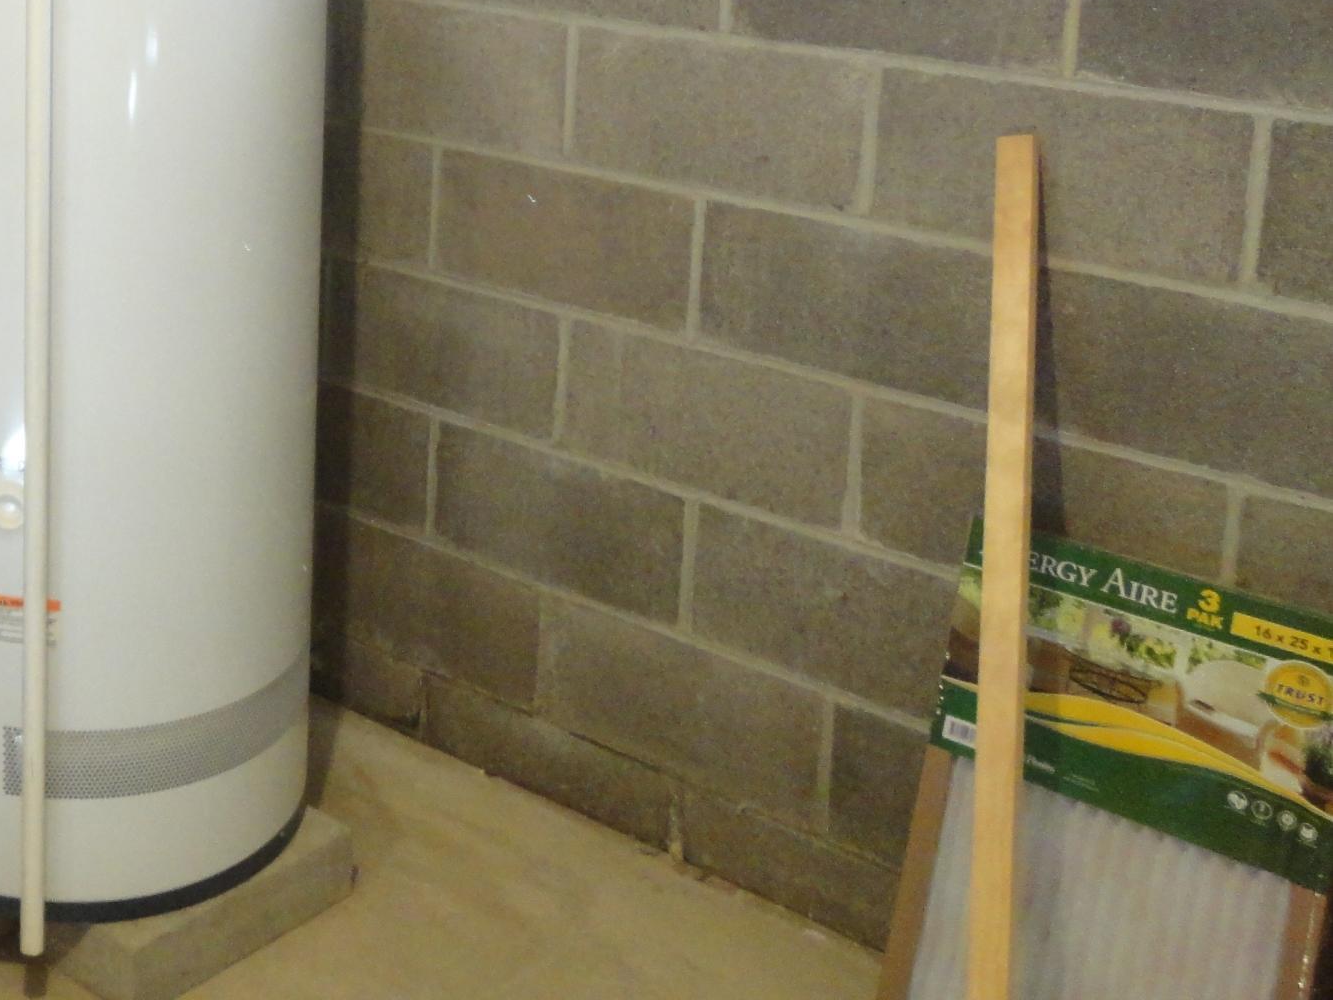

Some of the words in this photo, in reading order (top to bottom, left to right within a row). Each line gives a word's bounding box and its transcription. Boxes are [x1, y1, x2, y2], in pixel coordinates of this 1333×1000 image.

[1099, 567, 1179, 614] AIRE
[1198, 589, 1221, 613] 3
[1186, 607, 1224, 630] PAK
[1255, 625, 1272, 640] 16
[1290, 634, 1309, 650] 25
[1277, 682, 1325, 706] TRUST
